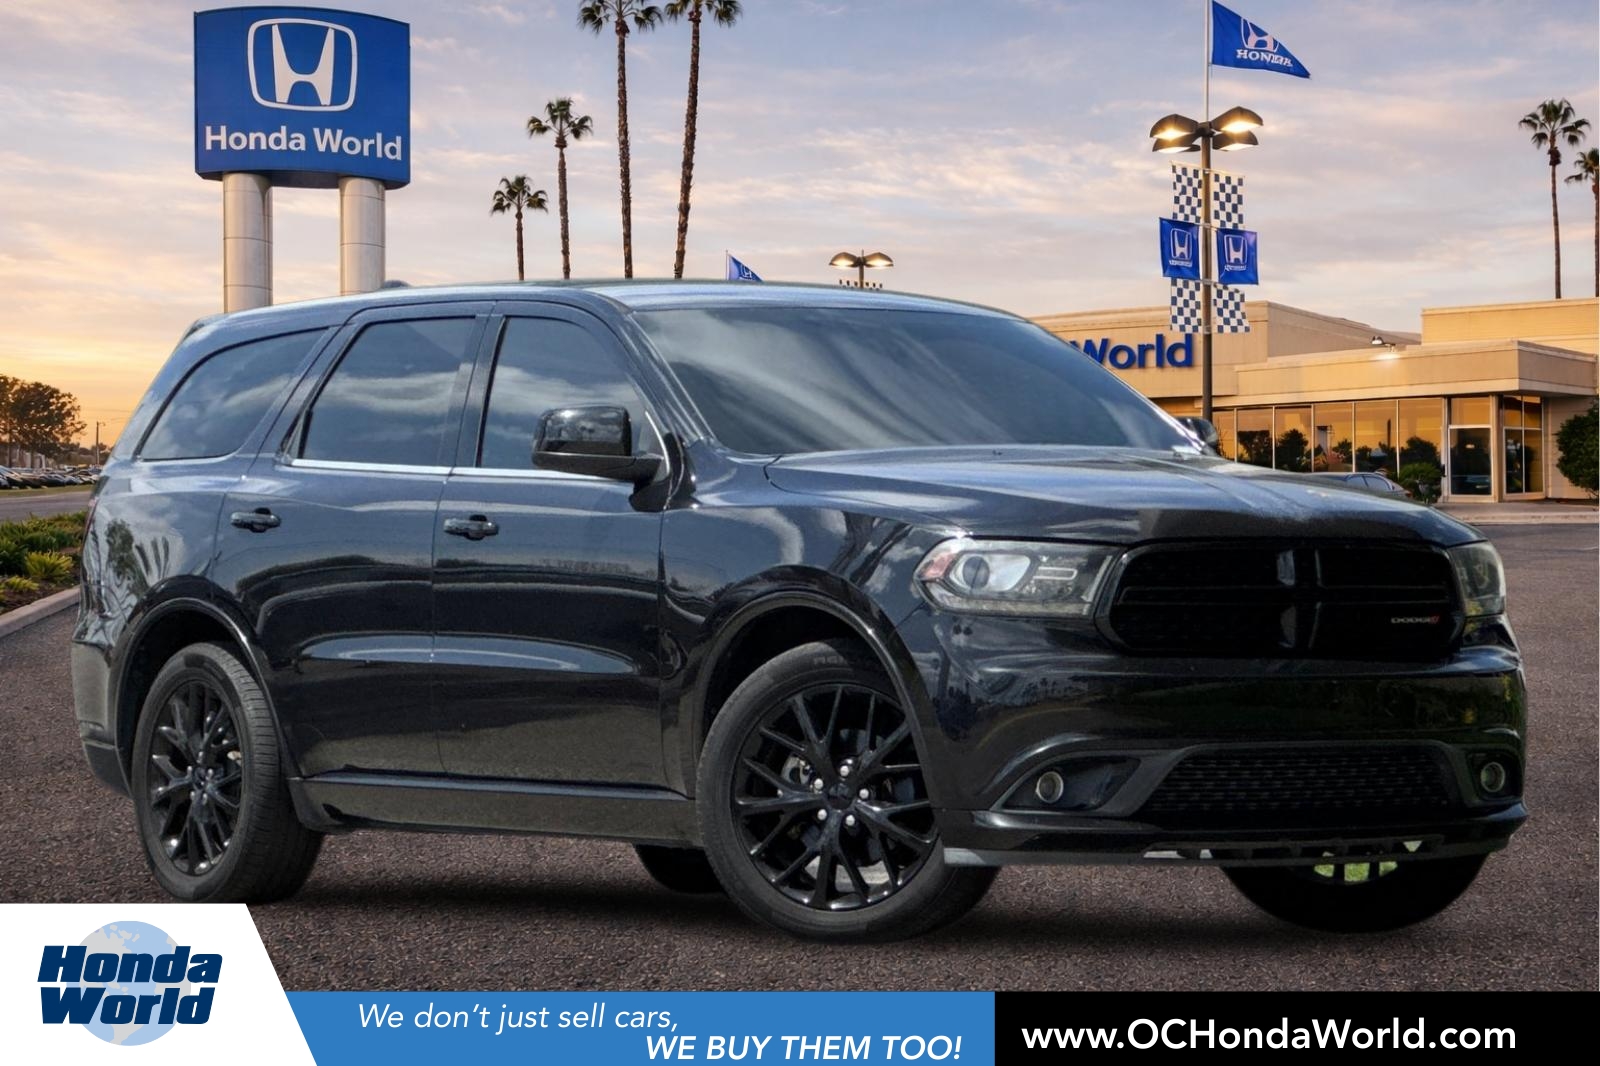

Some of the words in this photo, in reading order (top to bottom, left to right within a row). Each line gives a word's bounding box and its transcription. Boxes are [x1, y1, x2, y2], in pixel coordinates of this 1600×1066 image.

[205, 125, 306, 151] Honda
[313, 127, 402, 160] World
[1391, 616, 1433, 624] DODGE
